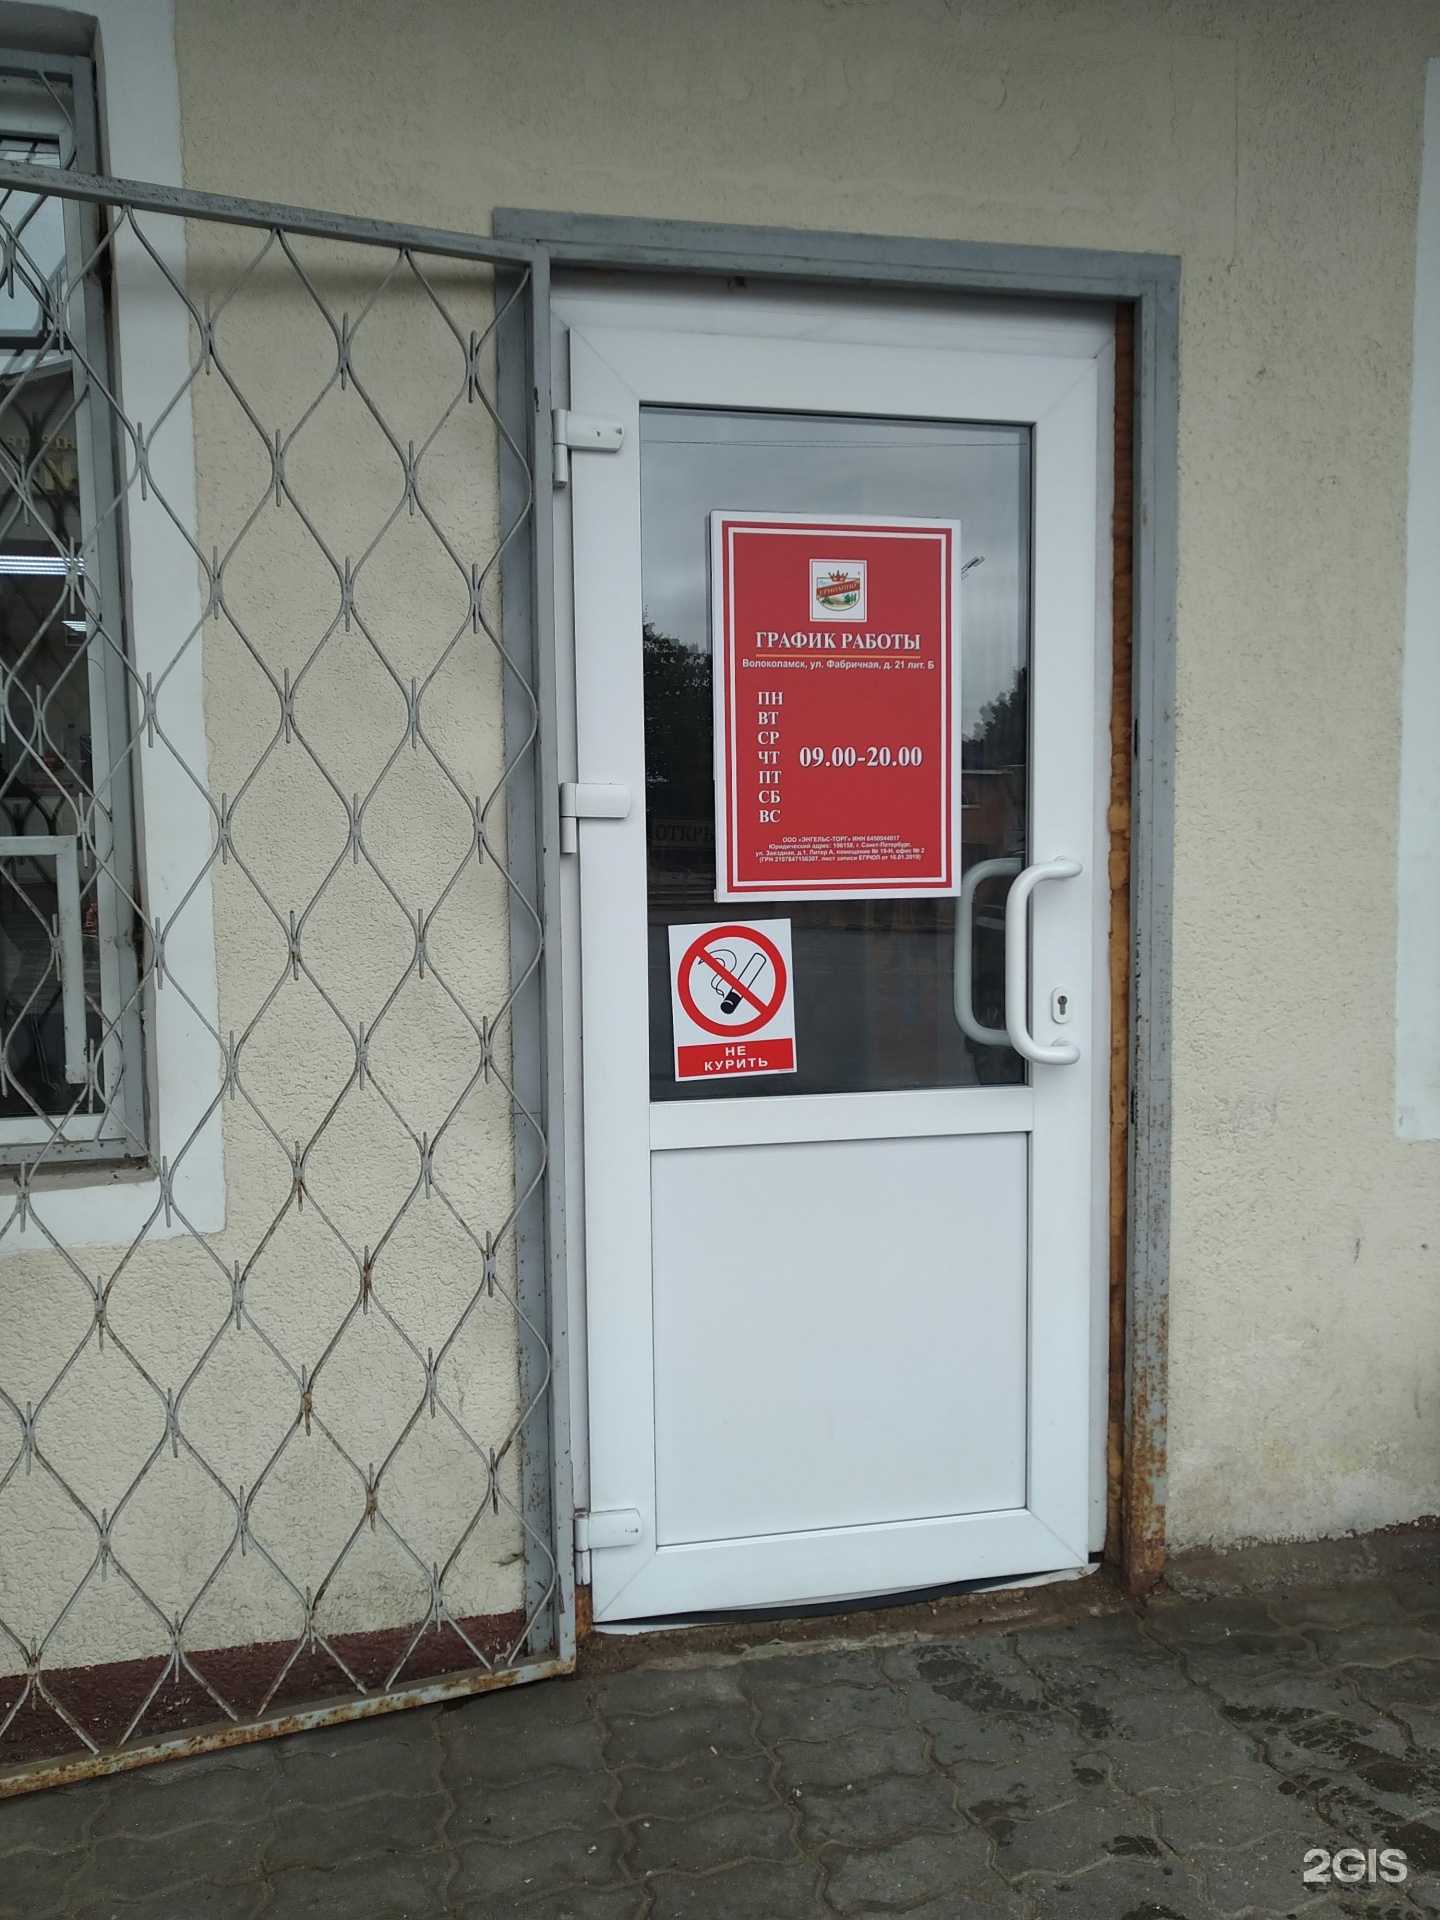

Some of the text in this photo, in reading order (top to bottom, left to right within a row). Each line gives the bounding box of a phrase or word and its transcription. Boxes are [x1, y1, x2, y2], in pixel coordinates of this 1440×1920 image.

[756, 632, 921, 650] ГРАФИК РАБОТЫ
[810, 661, 823, 670] ул.
[826, 659, 881, 670] Фабричная,
[883, 661, 892, 670] д.
[895, 660, 904, 669] 21
[908, 661, 925, 669] лит.
[928, 660, 935, 669] Б
[758, 692, 783, 705] ПН
[758, 712, 779, 725] ВТ
[758, 731, 780, 745] СР
[758, 751, 780, 765] ЧТ
[800, 746, 923, 767] 09.00-20.00
[759, 771, 782, 784] ПТ
[758, 790, 781, 804] СБ
[759, 810, 781, 823] ВС
[725, 1045, 746, 1057] НЕ
[704, 1057, 768, 1072] КУРИТЬ
